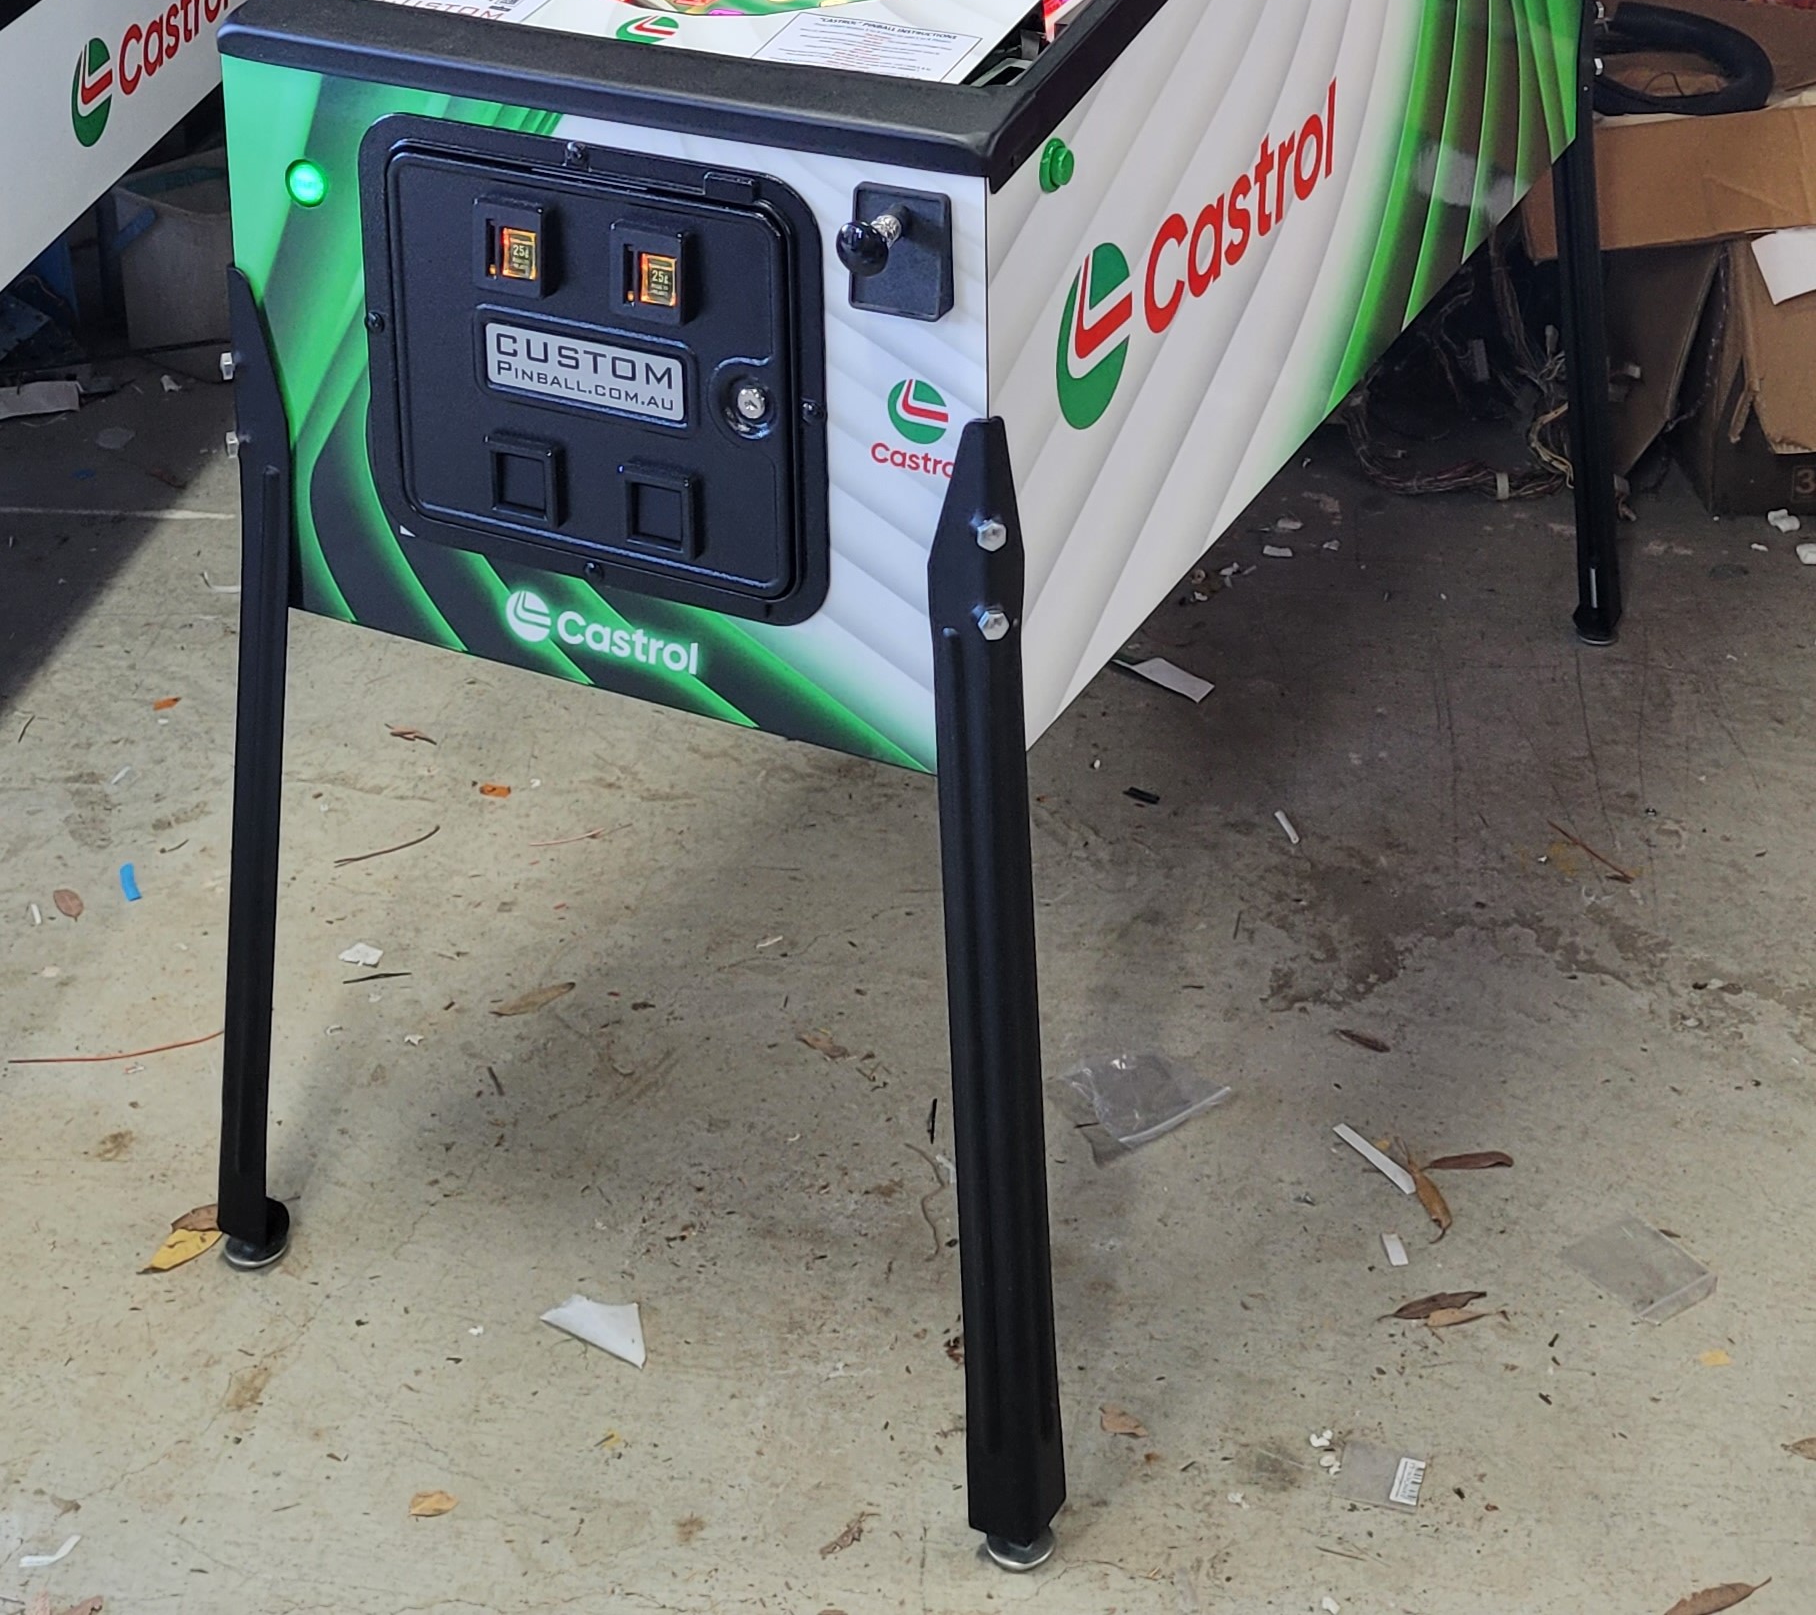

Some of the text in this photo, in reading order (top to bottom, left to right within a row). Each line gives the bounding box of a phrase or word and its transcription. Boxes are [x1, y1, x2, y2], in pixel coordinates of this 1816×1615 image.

[1144, 76, 1337, 334] Castrol
[496, 332, 673, 390] CUSTOM
[871, 442, 955, 479] Castro
[557, 610, 699, 676] Castrol
